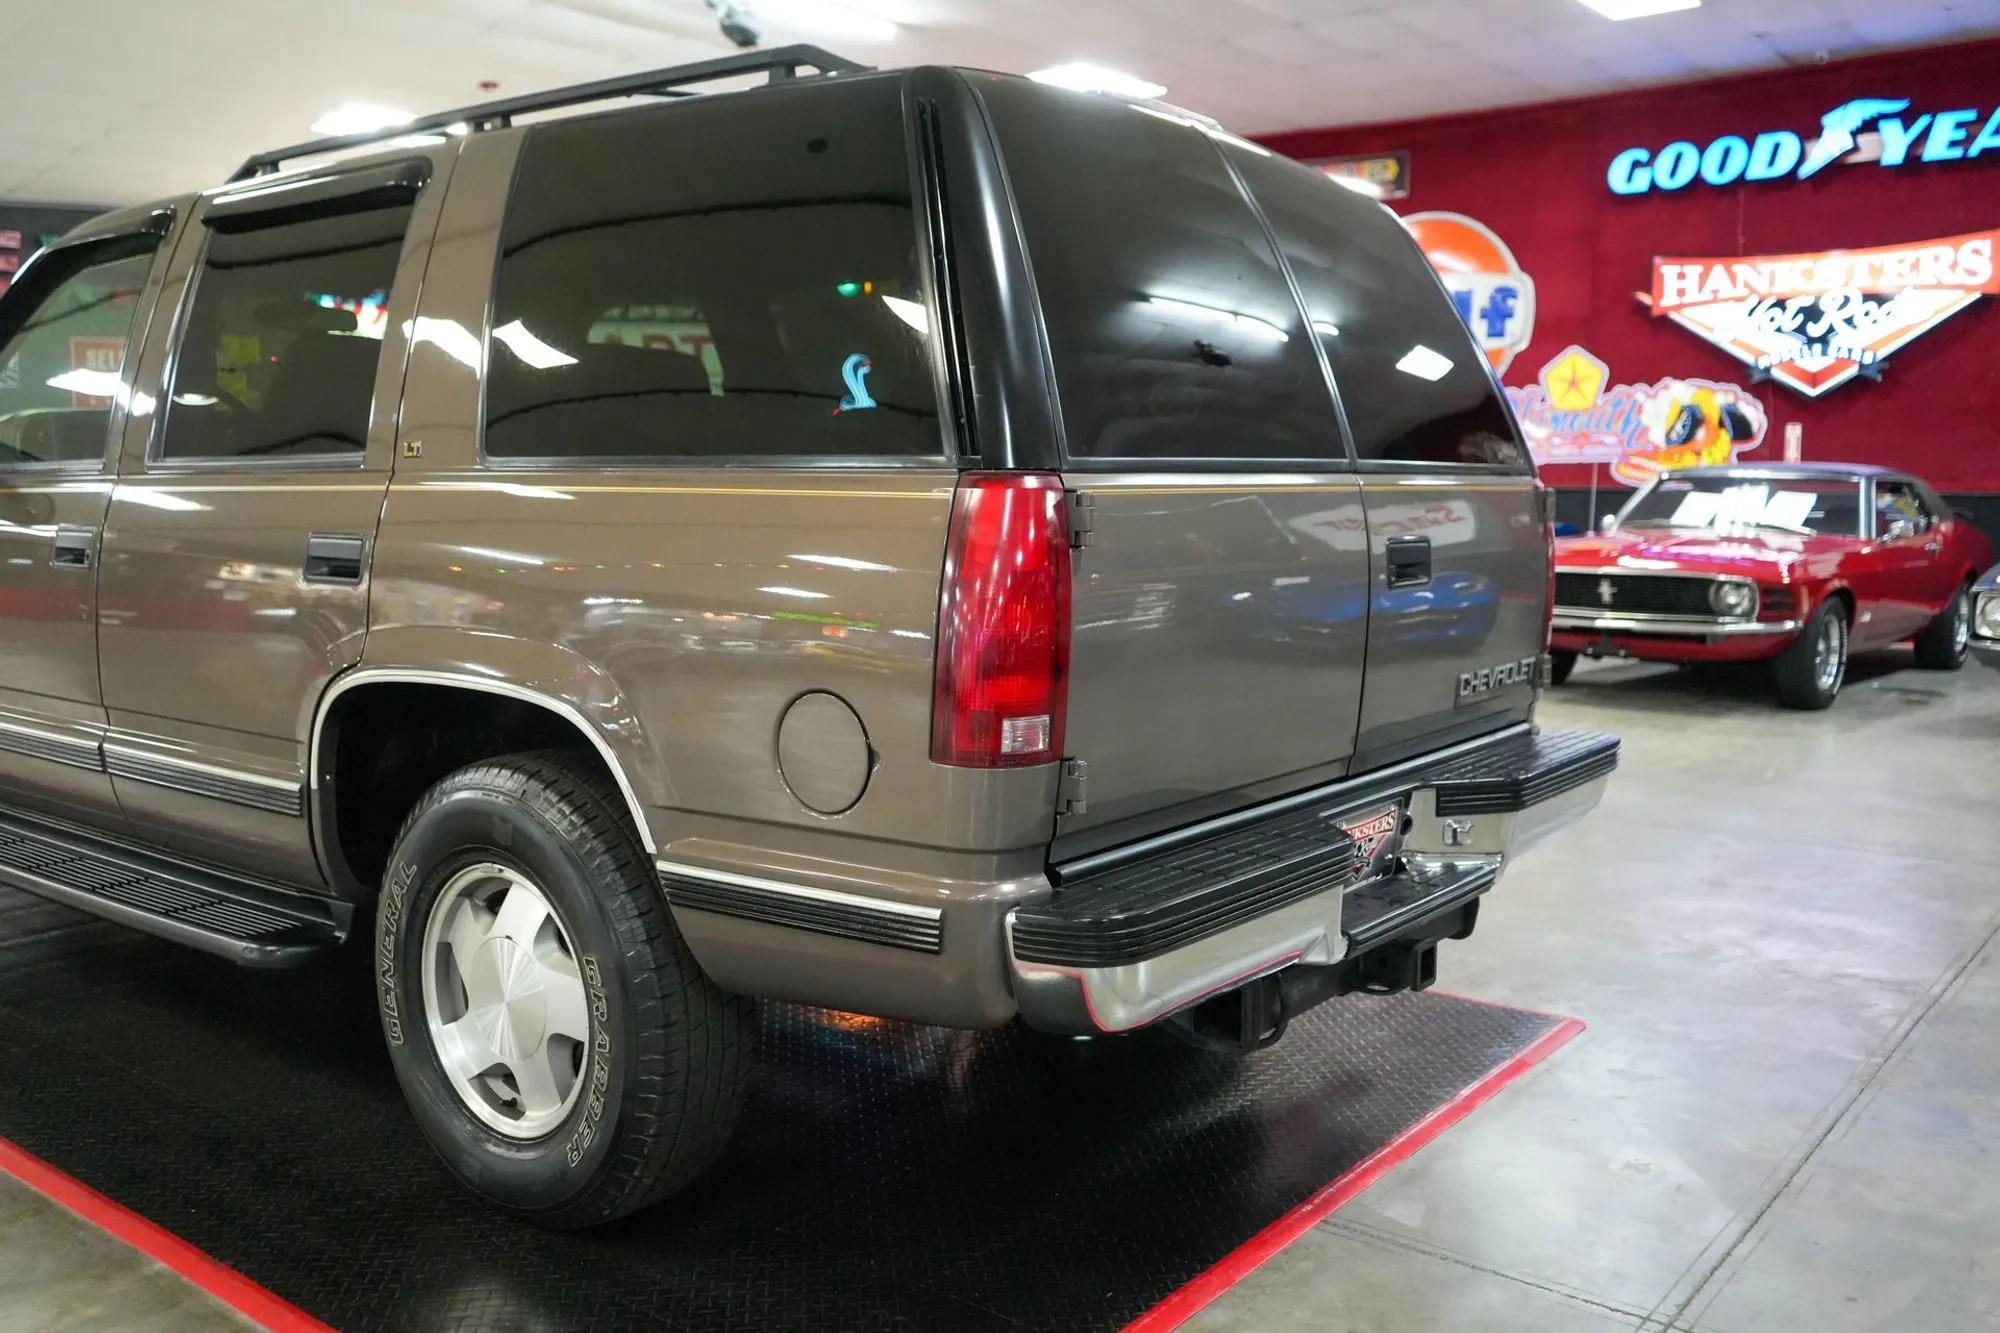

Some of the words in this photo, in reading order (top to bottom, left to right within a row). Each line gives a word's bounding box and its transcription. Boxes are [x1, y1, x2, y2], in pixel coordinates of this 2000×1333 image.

[1606, 130, 1802, 195] GOOD
[1659, 239, 1993, 307] HANKSTERS
[1460, 656, 1536, 696] CHEVROLET
[377, 863, 418, 1045] GENERAL
[566, 956, 611, 1168] GRABBER
